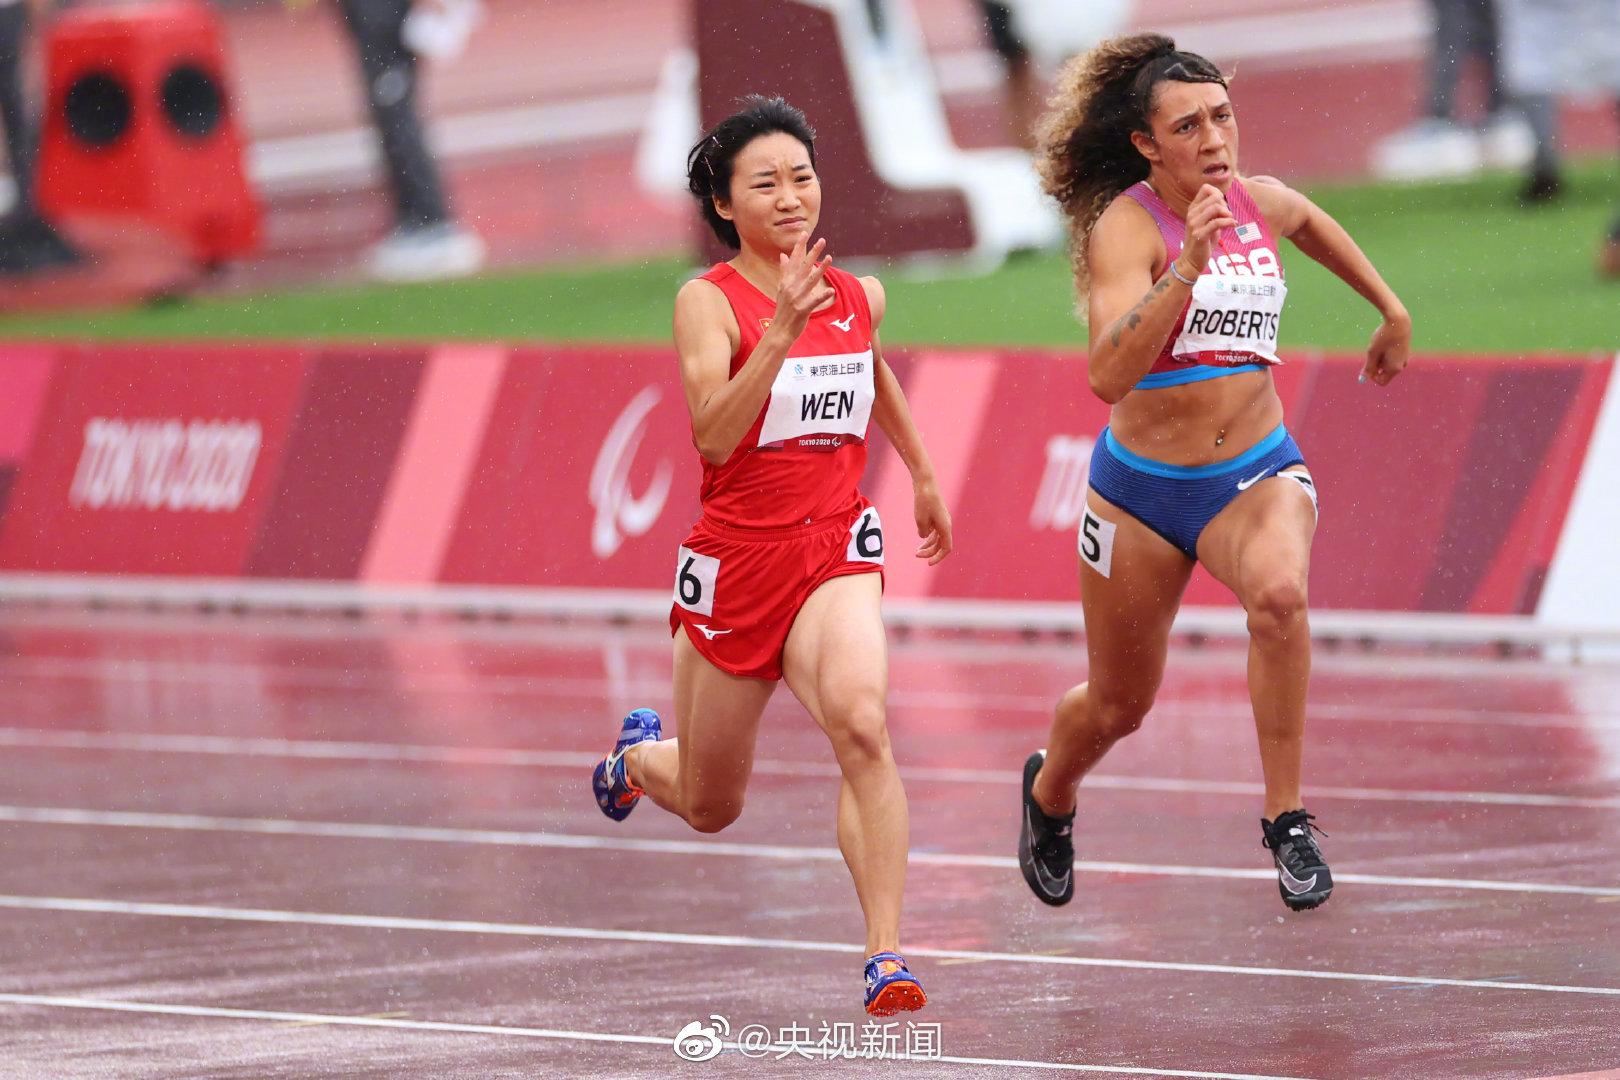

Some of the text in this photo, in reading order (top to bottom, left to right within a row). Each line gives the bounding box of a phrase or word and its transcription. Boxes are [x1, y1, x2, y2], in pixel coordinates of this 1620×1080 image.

[1188, 309, 1278, 341] ROBERTS
[810, 362, 865, 377] 東京海上日動
[801, 390, 855, 421] WEN
[857, 513, 883, 558] 6
[1082, 512, 1101, 563] 5
[679, 556, 701, 605] 6
